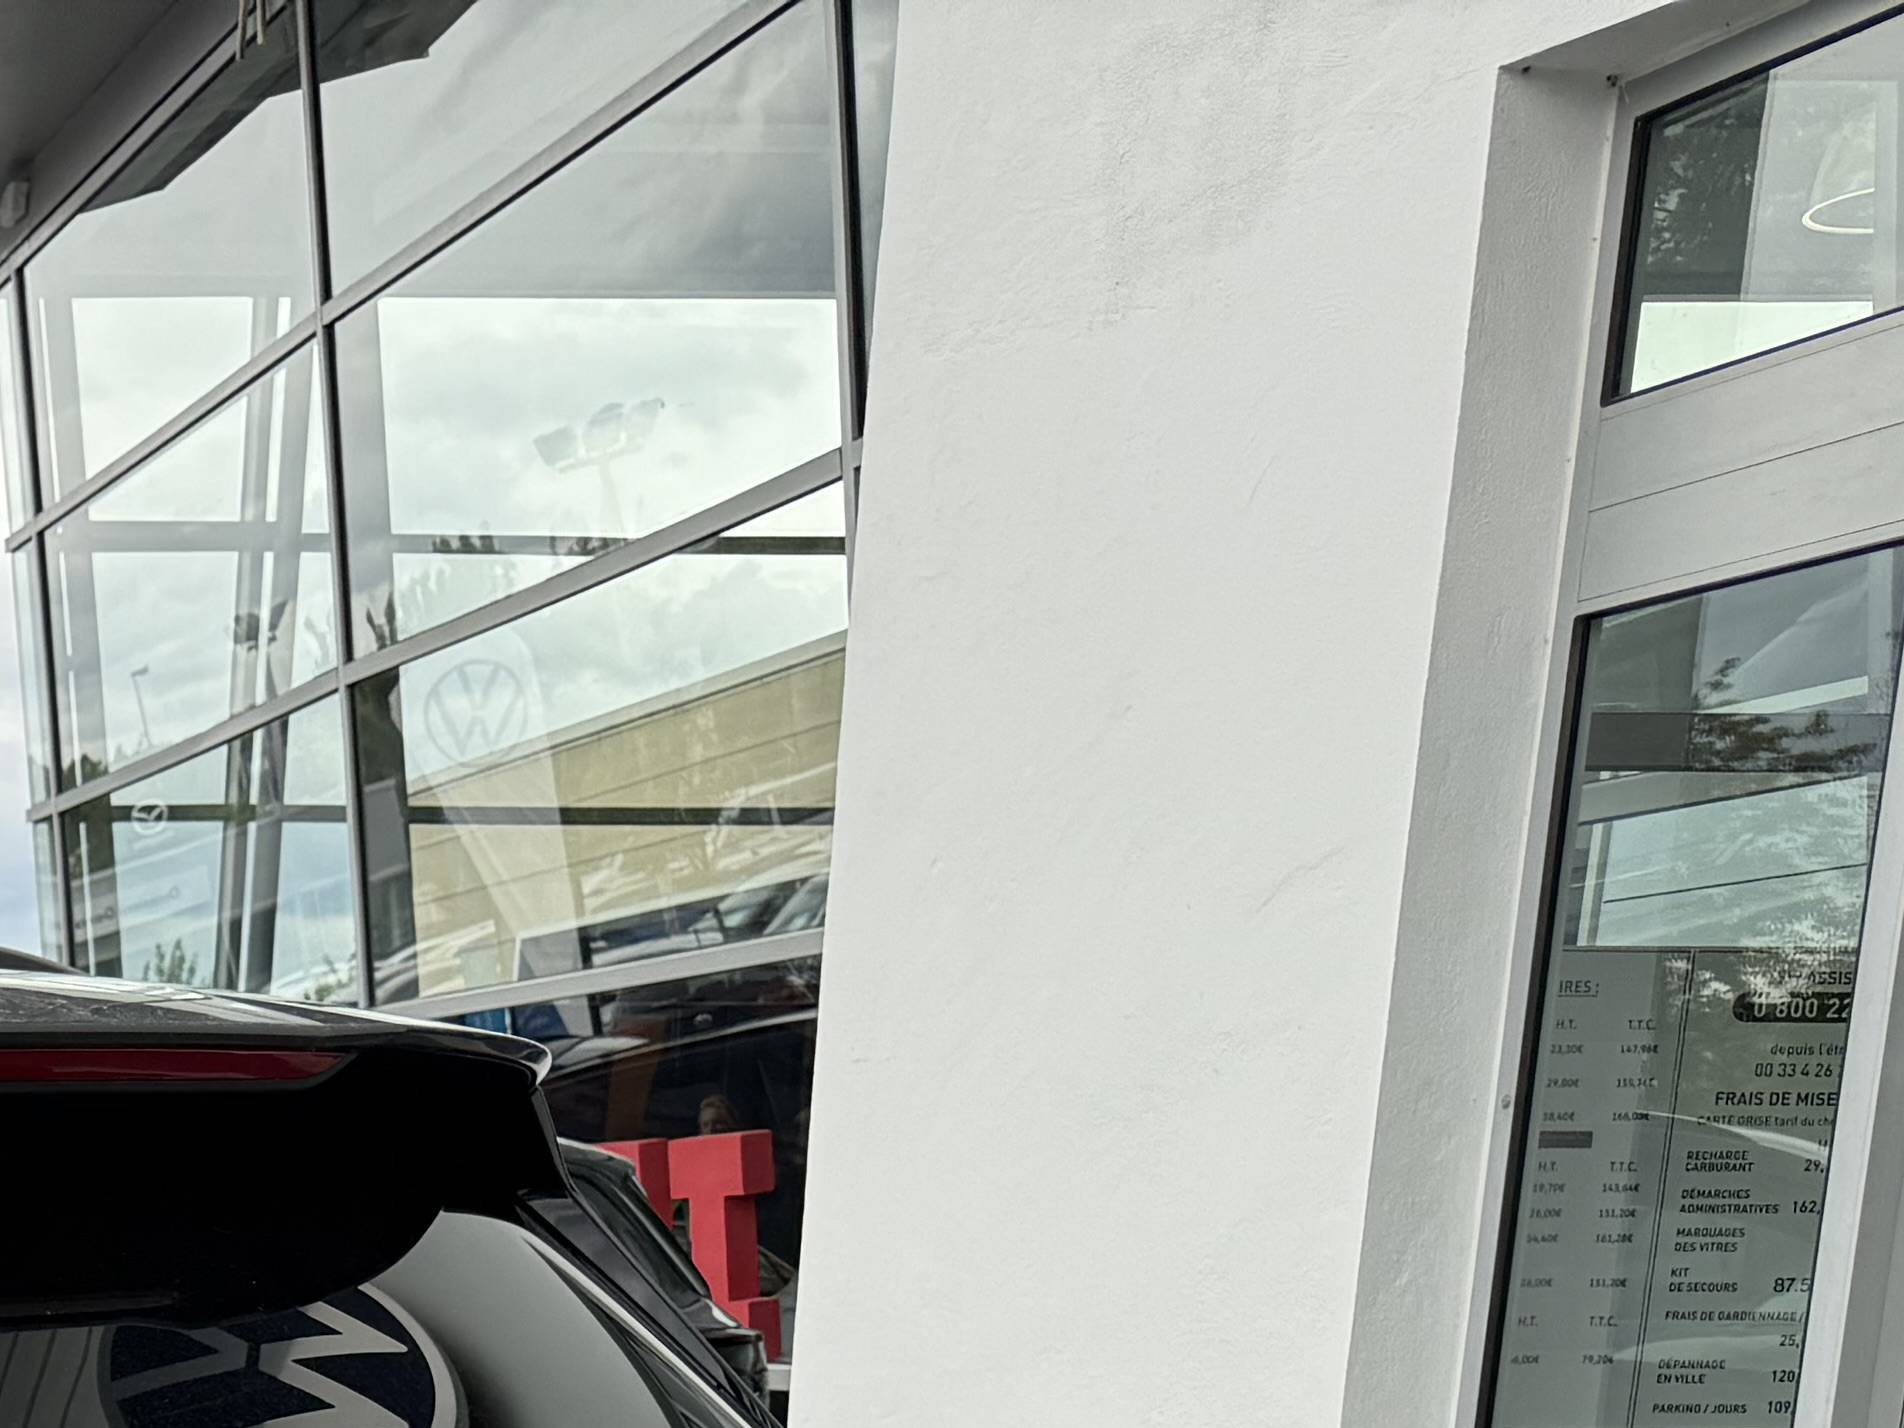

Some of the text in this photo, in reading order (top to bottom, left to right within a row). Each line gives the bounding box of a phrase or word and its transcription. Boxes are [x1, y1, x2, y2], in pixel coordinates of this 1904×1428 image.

[1770, 1043, 1815, 1059] depuis
[1754, 1062, 1833, 1078] 00 33 4 26
[1715, 1091, 1838, 1107] FRAIS DE MISE
[1687, 1151, 1748, 1162] RECHARGE
[1685, 1162, 1755, 1173] CARBURANT
[1679, 1204, 1780, 1215] ADMINISTRATIVES
[1676, 1227, 1746, 1239] MARQUAGES
[1674, 1242, 1739, 1253] DES VITRES
[1670, 1267, 1690, 1278] KIT
[1669, 1282, 1683, 1293] DE
[1686, 1282, 1738, 1293] SECOURS
[1664, 1310, 1697, 1322] FRAIS
[1700, 1310, 1714, 1321] DE
[1718, 1310, 1797, 1322] GARDIENNAGE
[1656, 1374, 1671, 1384] EN
[1674, 1374, 1706, 1384] VILLE
[1652, 1403, 1701, 1414] PARKING
[1711, 1403, 1748, 1414] JOURS
